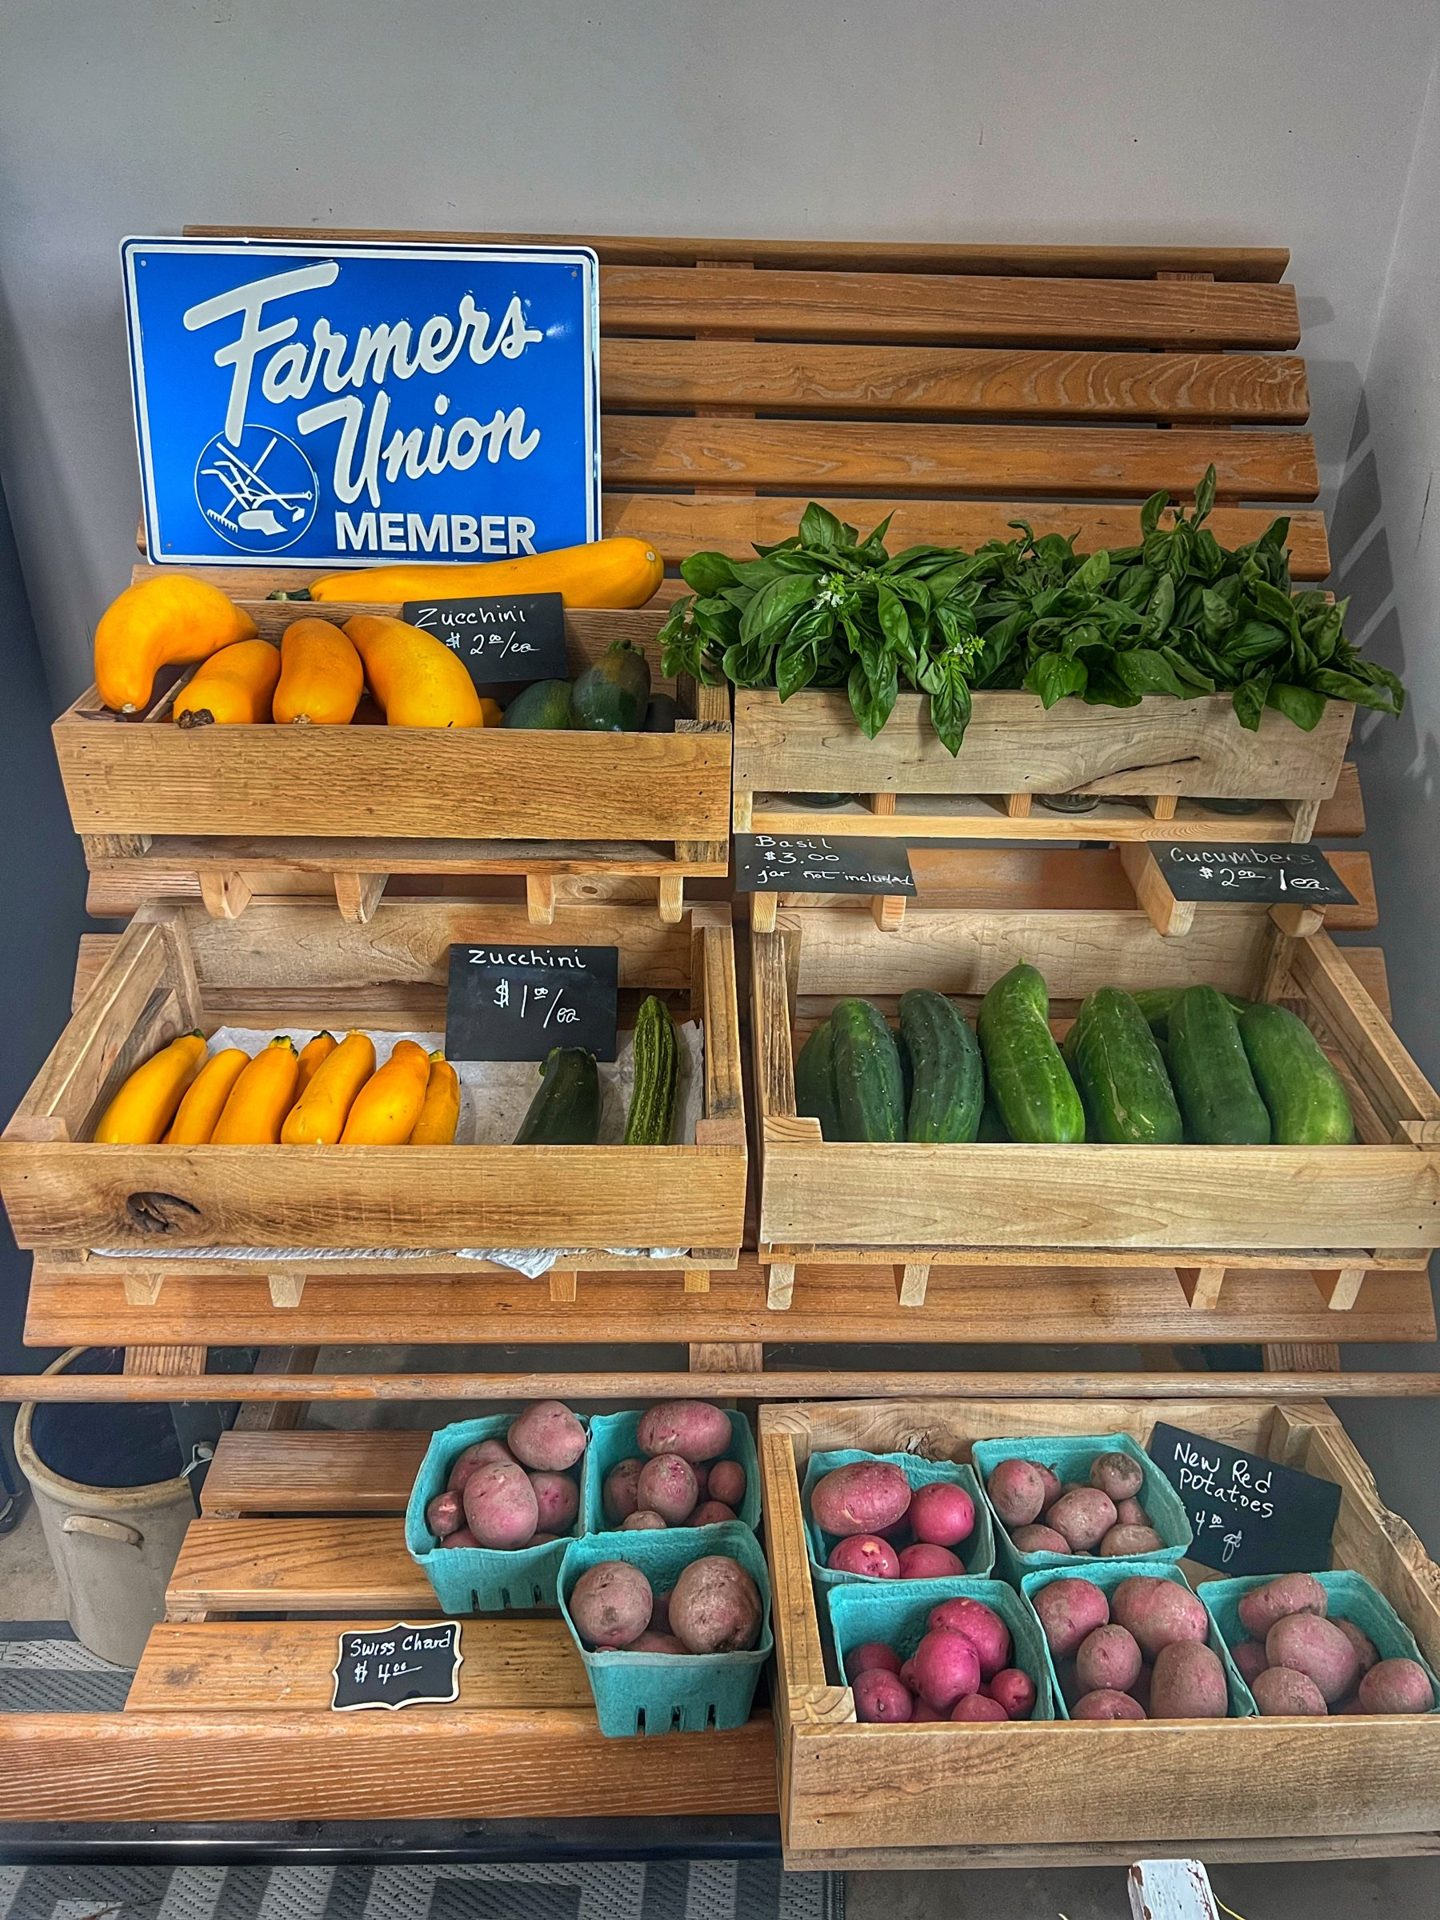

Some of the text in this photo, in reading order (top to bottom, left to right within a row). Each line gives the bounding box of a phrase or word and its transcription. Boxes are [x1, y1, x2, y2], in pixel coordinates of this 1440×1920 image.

[183, 260, 543, 446] Farmers
[297, 390, 541, 508] Union
[335, 511, 537, 555] MEMBER
[414, 604, 526, 628] Zucchini
[755, 836, 832, 849] Basil
[1170, 847, 1315, 864] Cucumbers
[764, 851, 840, 864] $3.00
[757, 866, 790, 884] jar
[803, 870, 840, 880] not
[1174, 1442, 1272, 1494] New Red
[350, 1629, 451, 1657] Swiss Chard
